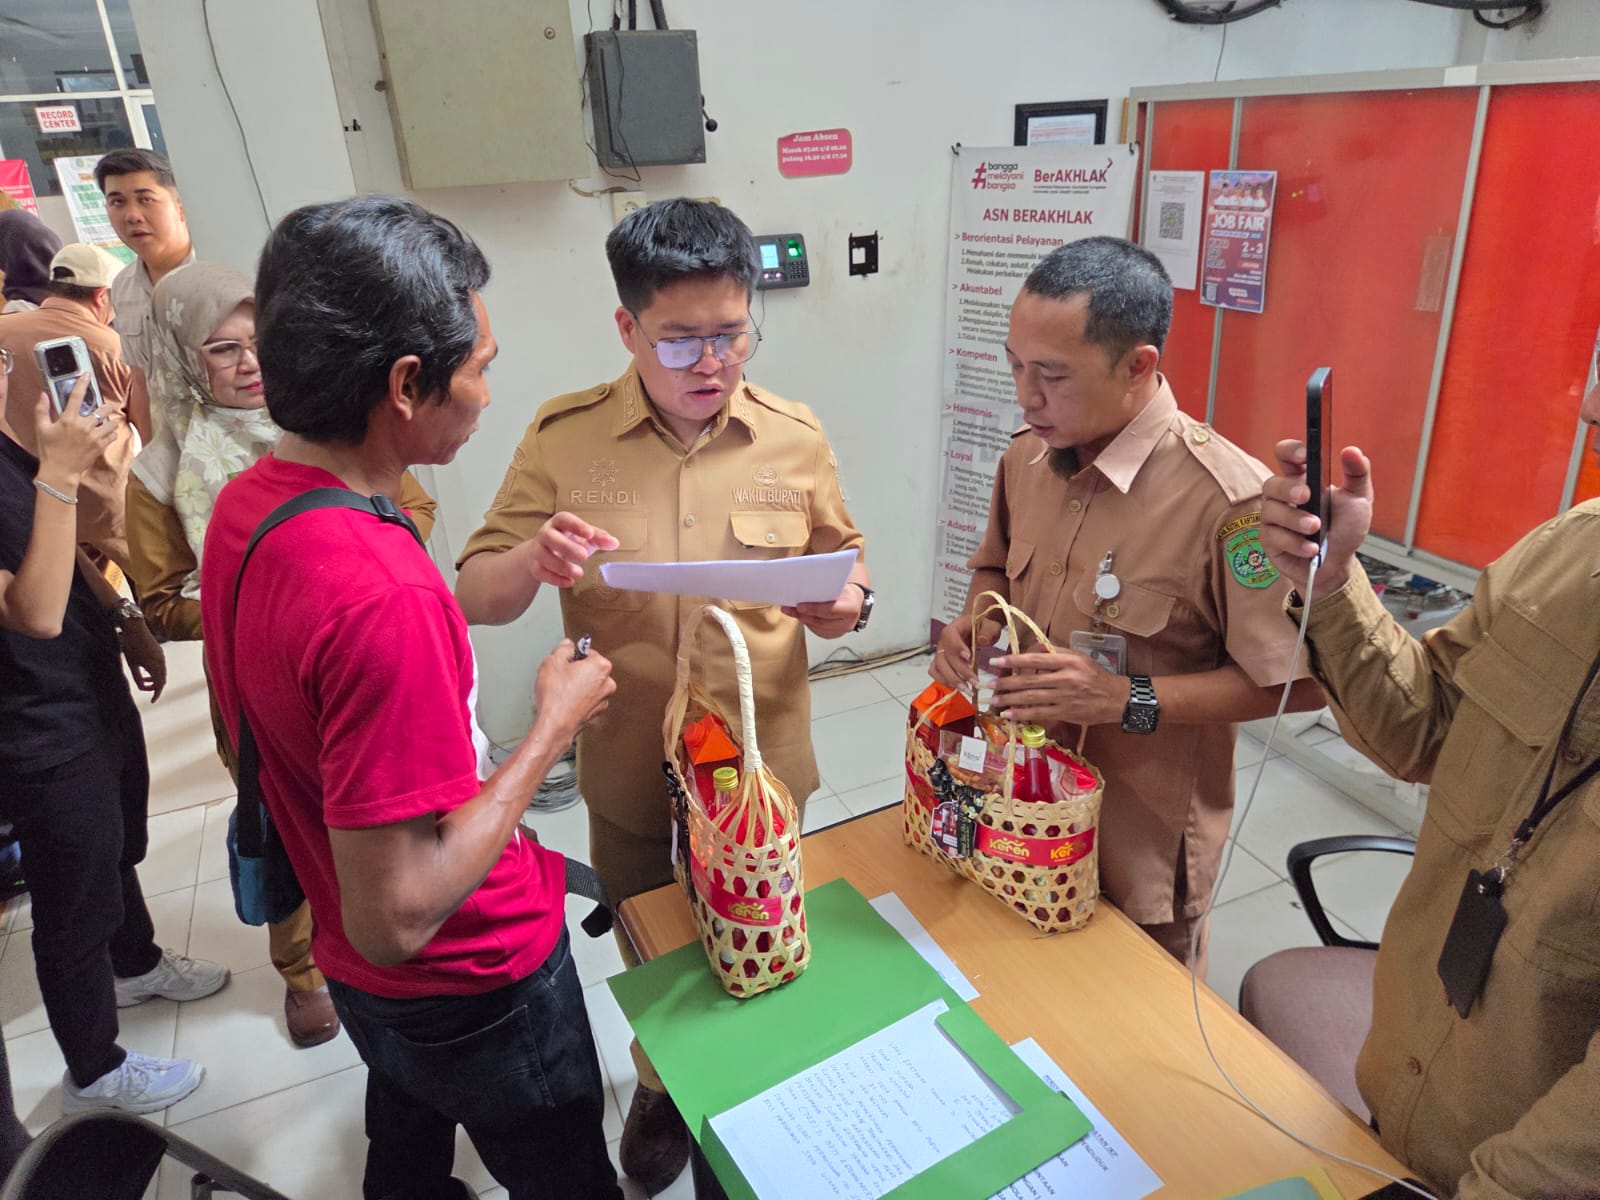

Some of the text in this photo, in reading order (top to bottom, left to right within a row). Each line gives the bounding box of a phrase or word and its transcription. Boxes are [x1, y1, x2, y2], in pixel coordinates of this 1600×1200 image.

[40, 110, 74, 119] RECORD
[43, 120, 77, 128] CENTER
[793, 133, 838, 142] Jam Absen
[988, 162, 1018, 173] bangga
[987, 171, 1024, 182] melayani
[1034, 169, 1107, 182] BerAKHLAK
[987, 181, 1016, 192] bangsa
[983, 208, 1093, 224] ASN BERAKHLAK
[1212, 214, 1266, 232] JOB FAIR
[962, 232, 1064, 248] Berorientasi Pelayanan
[960, 284, 1002, 296] Akuntabel
[956, 348, 998, 362] Kompeten
[953, 404, 992, 418] Harmonis
[950, 450, 972, 462] Loyal
[570, 490, 637, 505] RENDI
[732, 488, 764, 504] WAKIL
[947, 520, 977, 533] Adaptif
